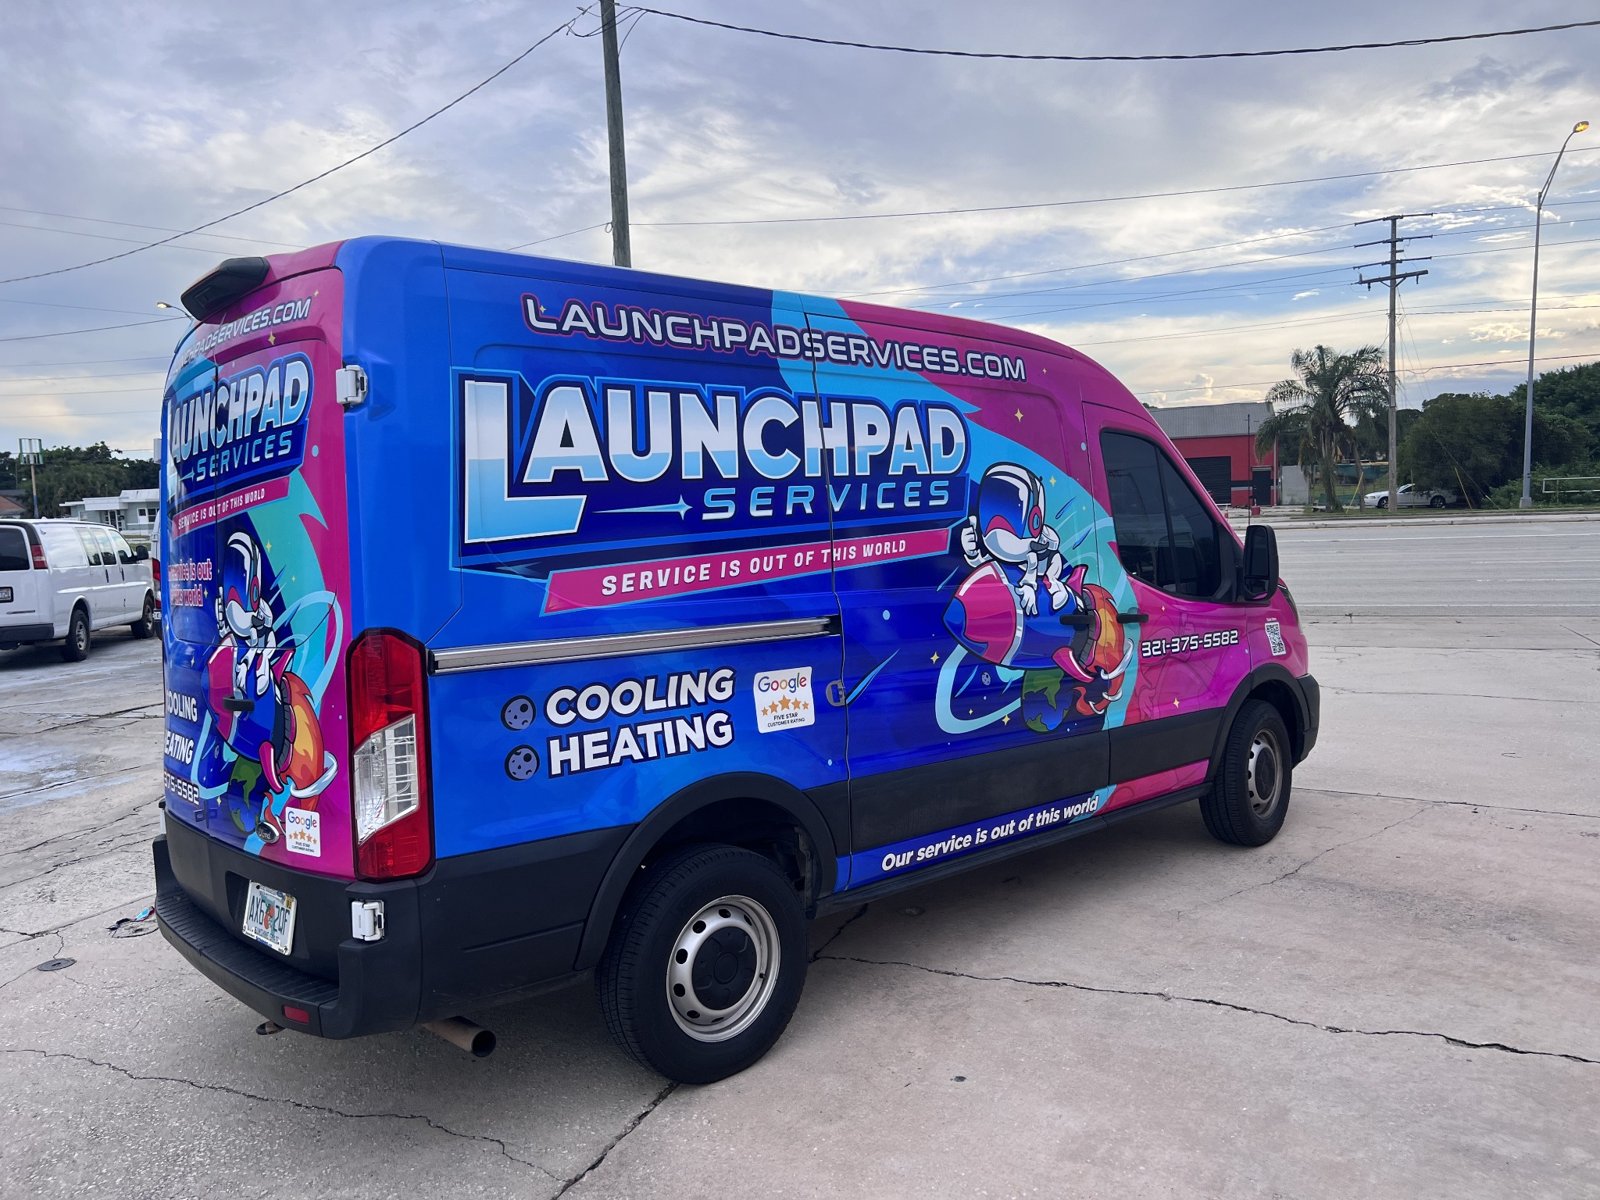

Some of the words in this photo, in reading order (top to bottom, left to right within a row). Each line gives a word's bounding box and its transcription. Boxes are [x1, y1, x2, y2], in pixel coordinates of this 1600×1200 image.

[525, 298, 1027, 380] LAUNCHPADSERVICES.COM
[196, 430, 293, 482] SERVICES
[464, 379, 966, 544] LAUNCHPAD
[178, 510, 199, 530] SERVICE
[200, 509, 207, 519] IS
[222, 501, 229, 513] OF
[230, 495, 243, 509] THIS
[245, 488, 265, 505] WORLD
[702, 480, 949, 520] SERVICES
[197, 558, 212, 580] out
[601, 563, 711, 596] SERVICE
[720, 559, 741, 579] IS
[749, 553, 787, 574] OUT
[794, 550, 814, 567] OF
[821, 545, 857, 563] THIS
[863, 539, 906, 557] WORLD
[1141, 630, 1238, 657] 321-375-5582
[546, 668, 734, 726] COOLING
[757, 672, 807, 694] Google
[549, 712, 733, 775] HEATING
[767, 719, 790, 728] CUSTOMER
[790, 717, 806, 725] RATING
[164, 730, 194, 765] EATING
[287, 811, 318, 830] Google
[881, 847, 914, 872] Our
[916, 834, 972, 861] service
[975, 827, 988, 845] is
[990, 821, 1015, 840] out
[1018, 813, 1033, 831] of
[1035, 807, 1060, 827] this
[1063, 795, 1099, 819] world
